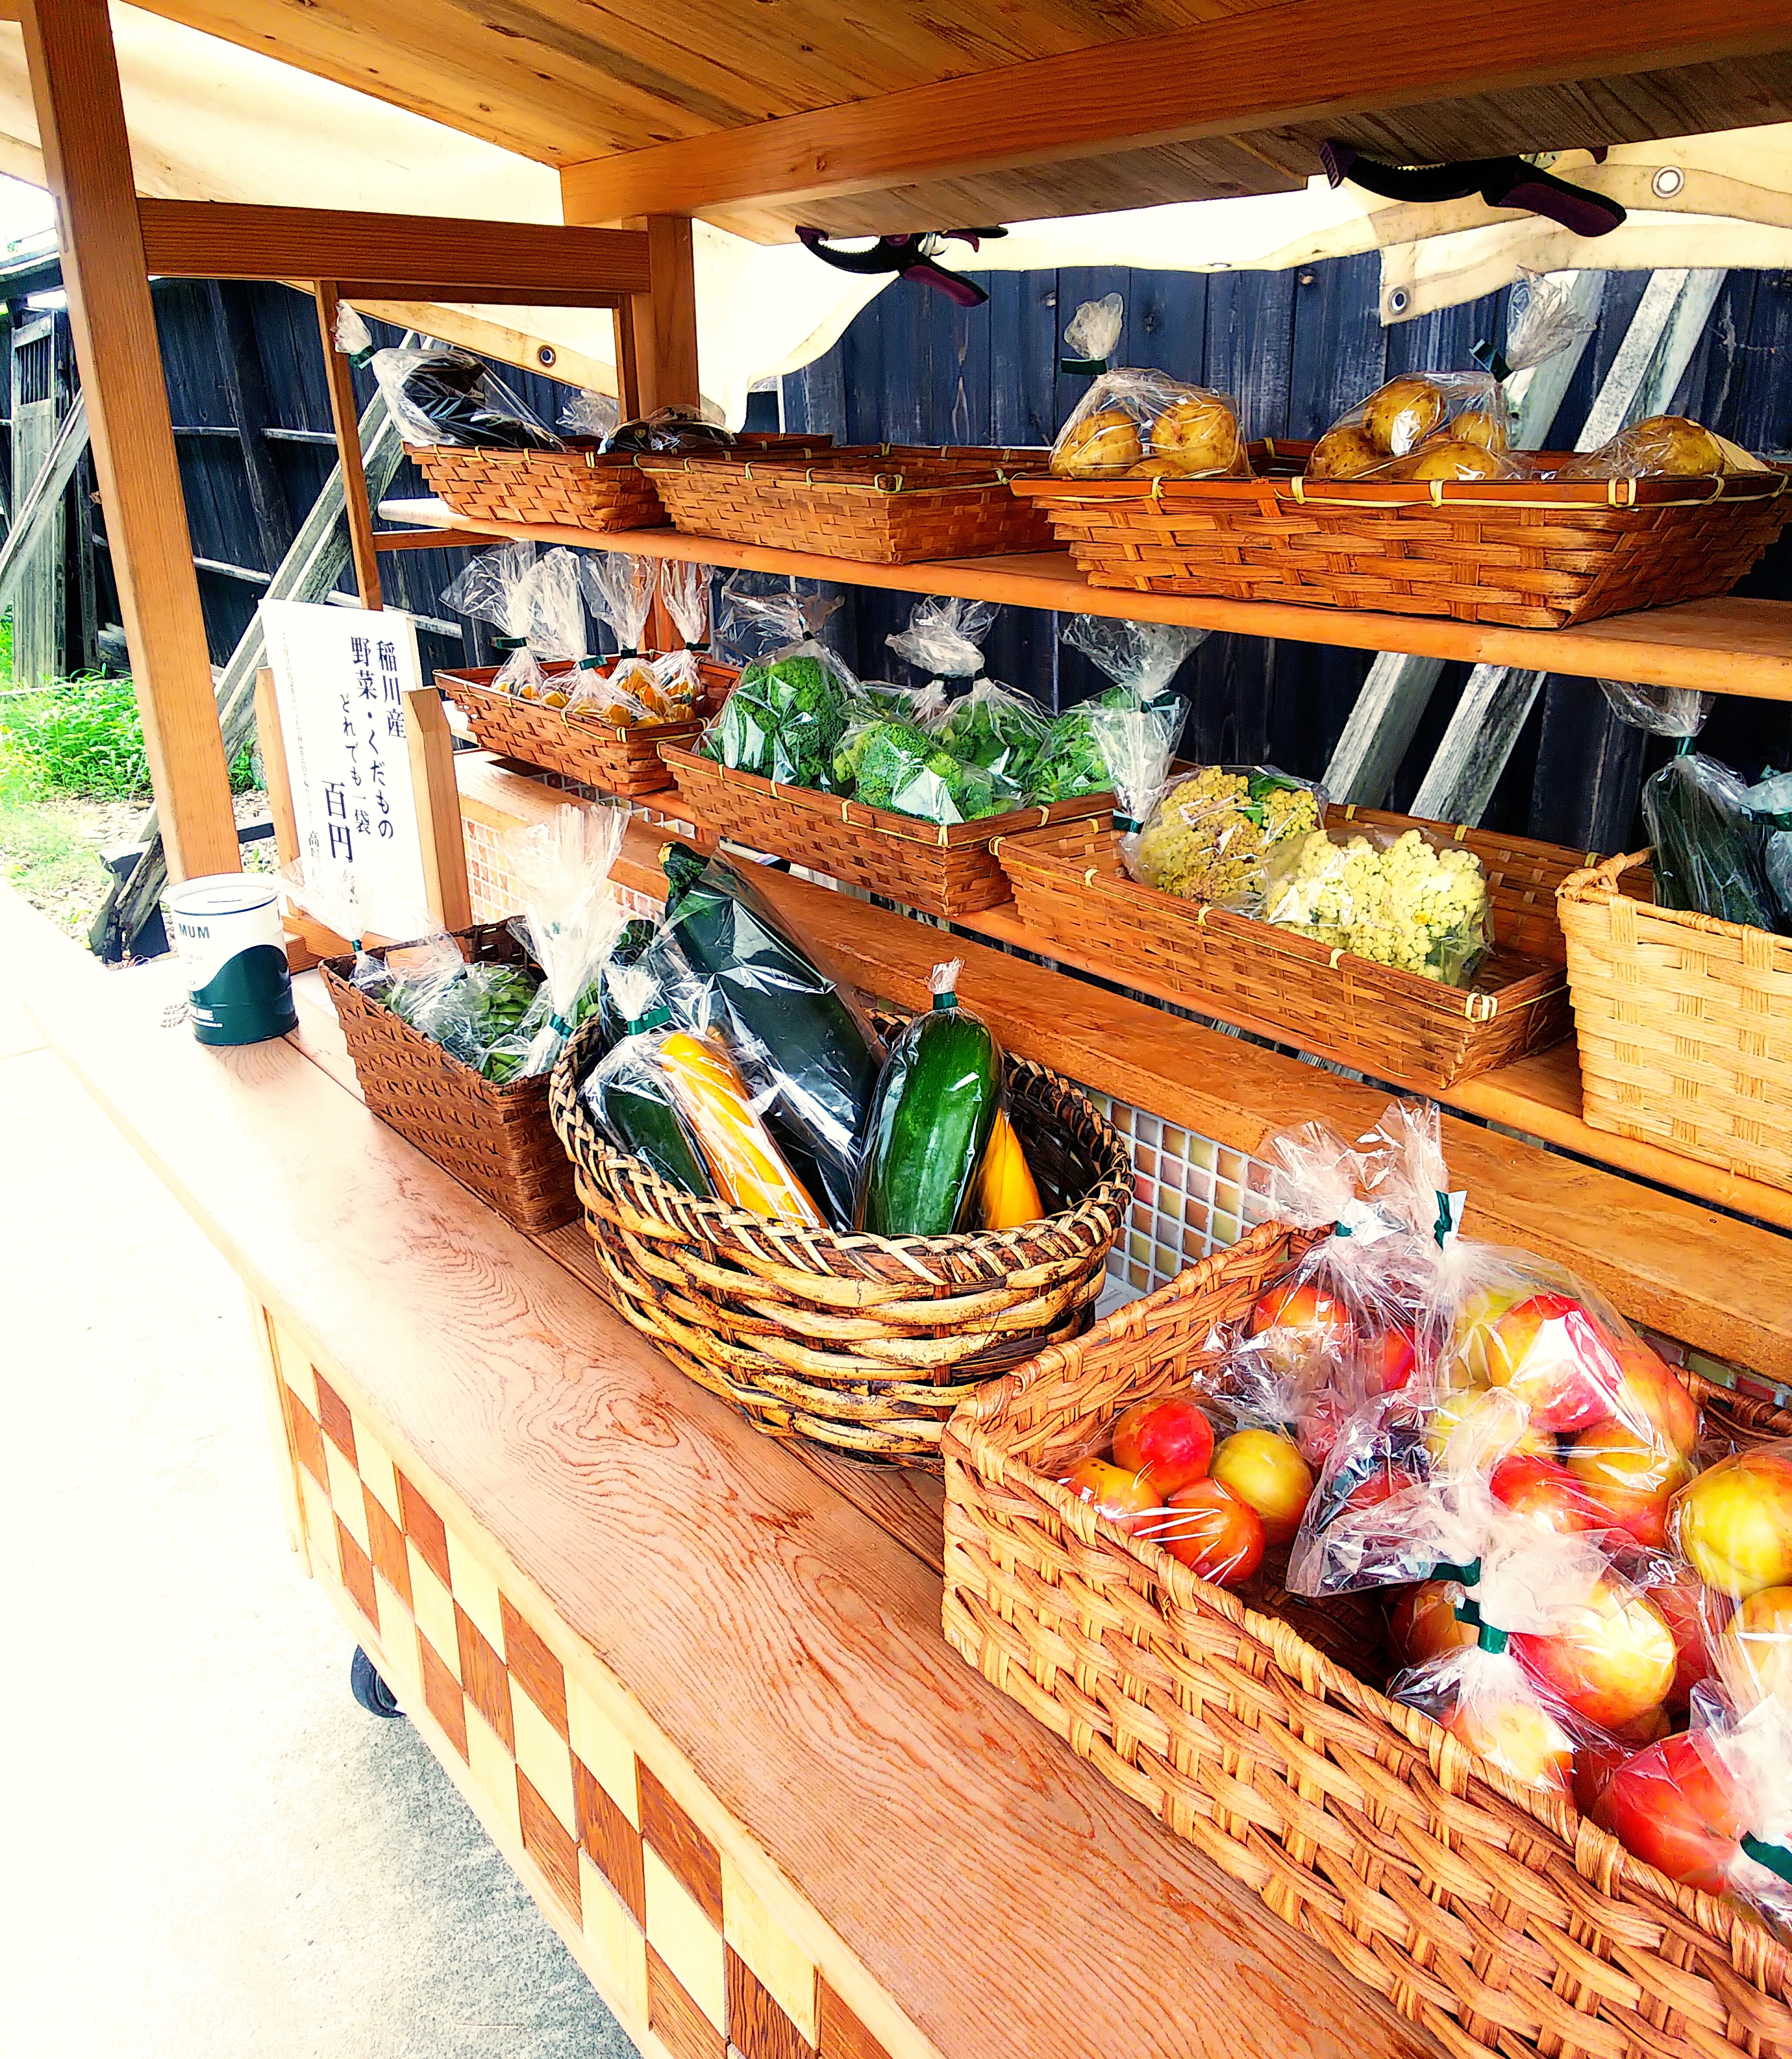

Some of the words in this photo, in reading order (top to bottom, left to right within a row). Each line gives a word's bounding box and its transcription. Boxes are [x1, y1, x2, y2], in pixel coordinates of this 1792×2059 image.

[351, 635, 394, 839] 野菜・くだもの
[376, 641, 407, 739] 稲川産
[321, 780, 353, 863] 百円
[340, 694, 372, 836] どれでも一袋
